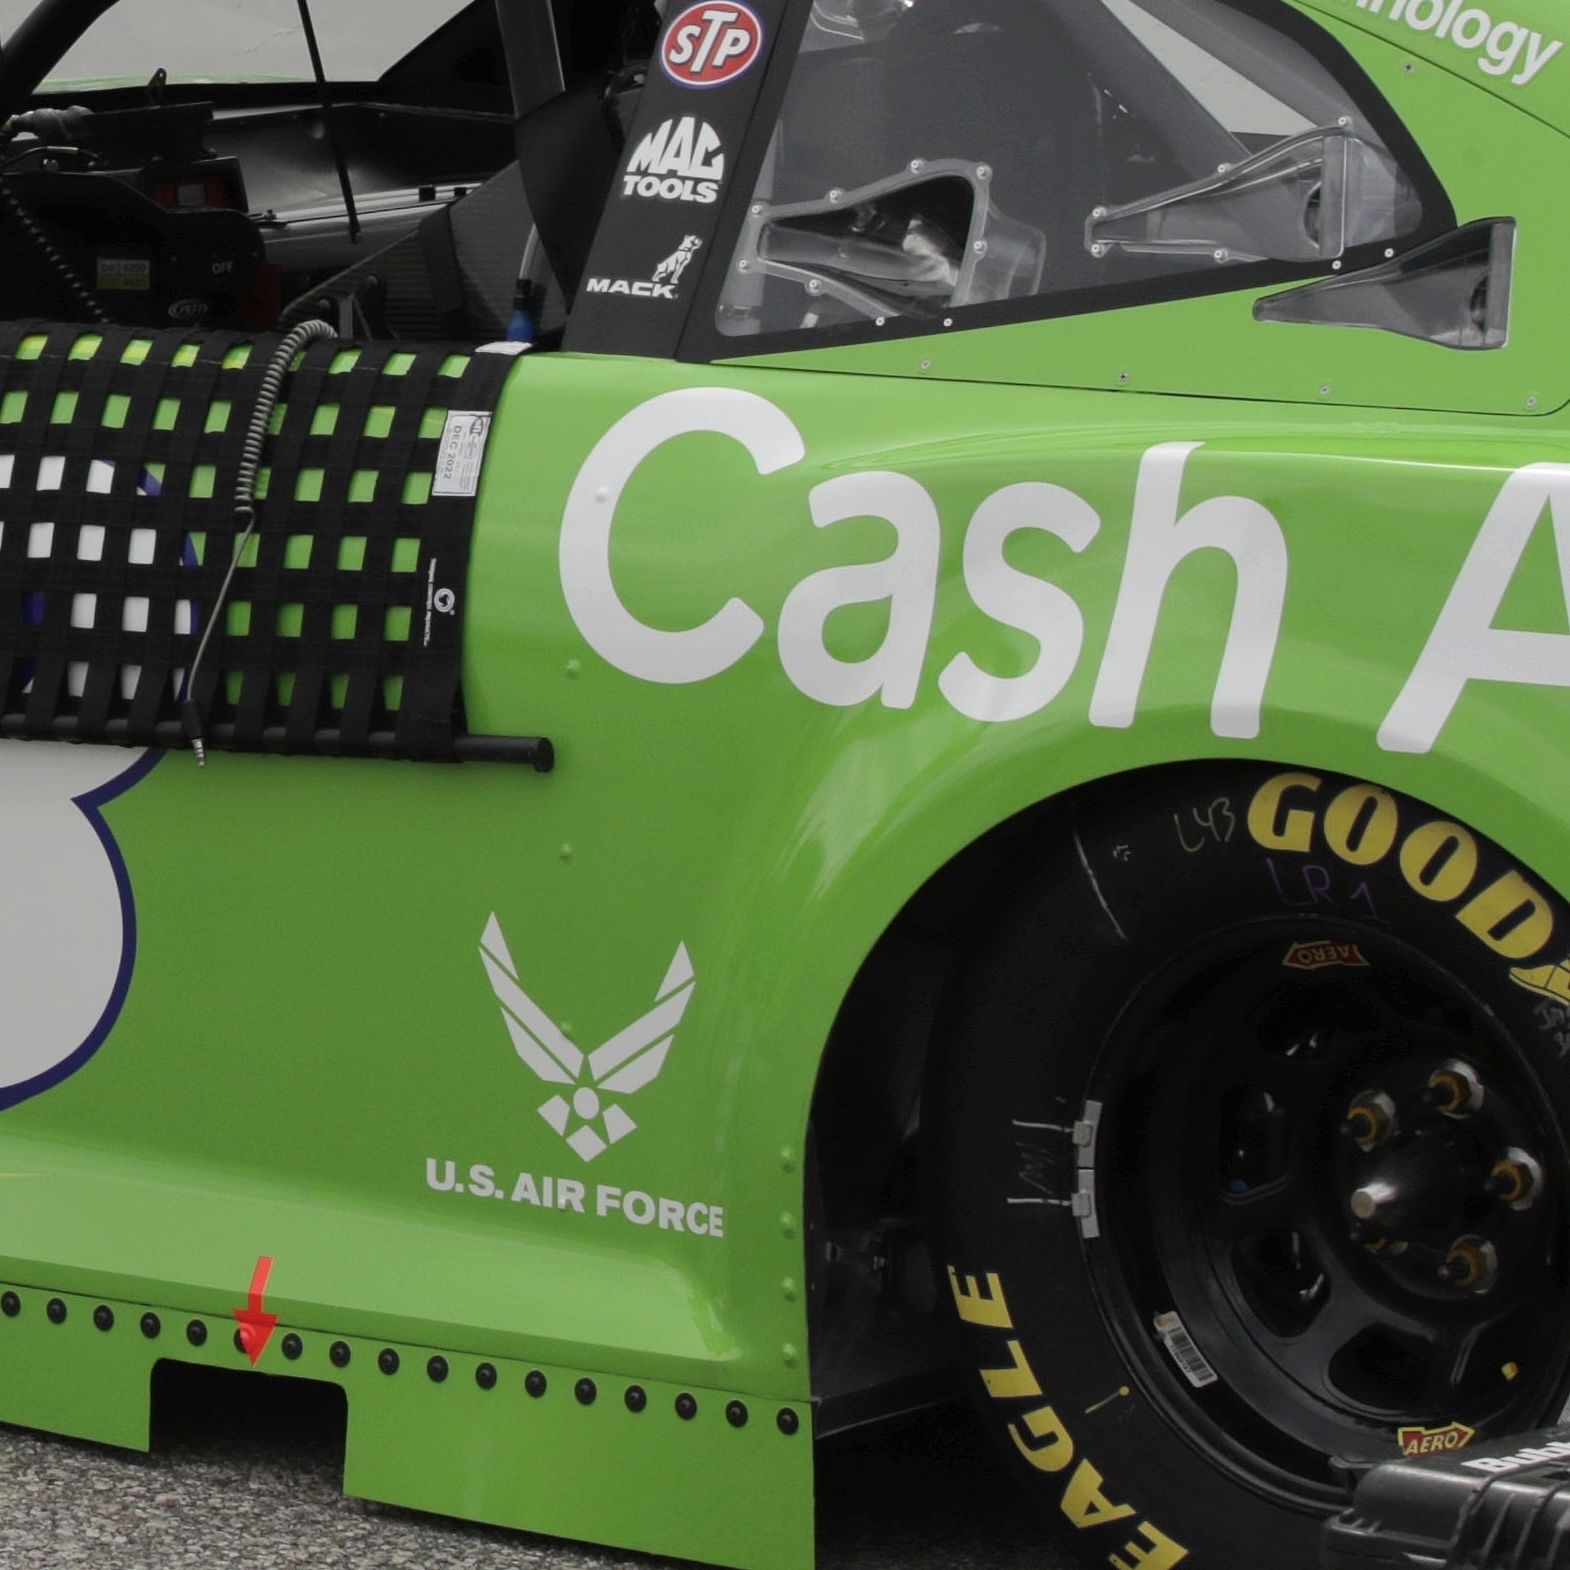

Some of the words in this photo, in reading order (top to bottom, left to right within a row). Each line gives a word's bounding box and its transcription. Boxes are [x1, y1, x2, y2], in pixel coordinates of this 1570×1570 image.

[669, 8, 752, 75] STP
[626, 116, 725, 181] MAC
[620, 175, 720, 204] TOOLS
[585, 277, 678, 299] MACK
[449, 425, 463, 450] DEC
[558, 385, 1289, 741] Cash
[1297, 942, 1358, 964] AERO
[425, 1157, 504, 1199] U.S.
[511, 1171, 585, 1214] AIR
[596, 1184, 724, 1238] FORCE
[1403, 1430, 1458, 1457] AERO
